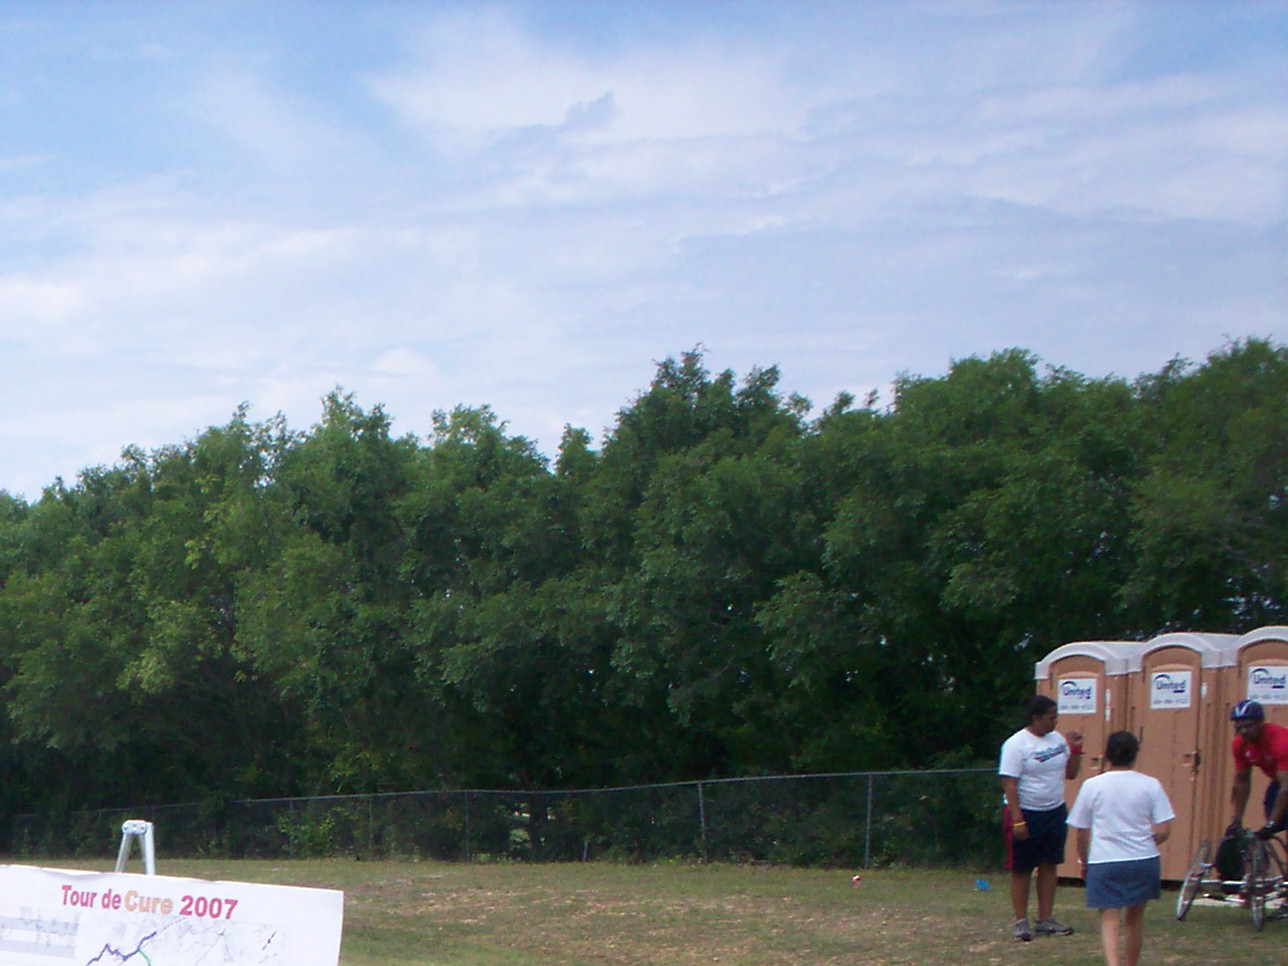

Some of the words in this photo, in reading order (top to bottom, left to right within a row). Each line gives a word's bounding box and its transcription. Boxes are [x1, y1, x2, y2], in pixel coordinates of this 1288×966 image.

[62, 885, 97, 908] Tour
[101, 889, 121, 910] de
[125, 890, 173, 915] Cure
[179, 895, 238, 919] 2007
